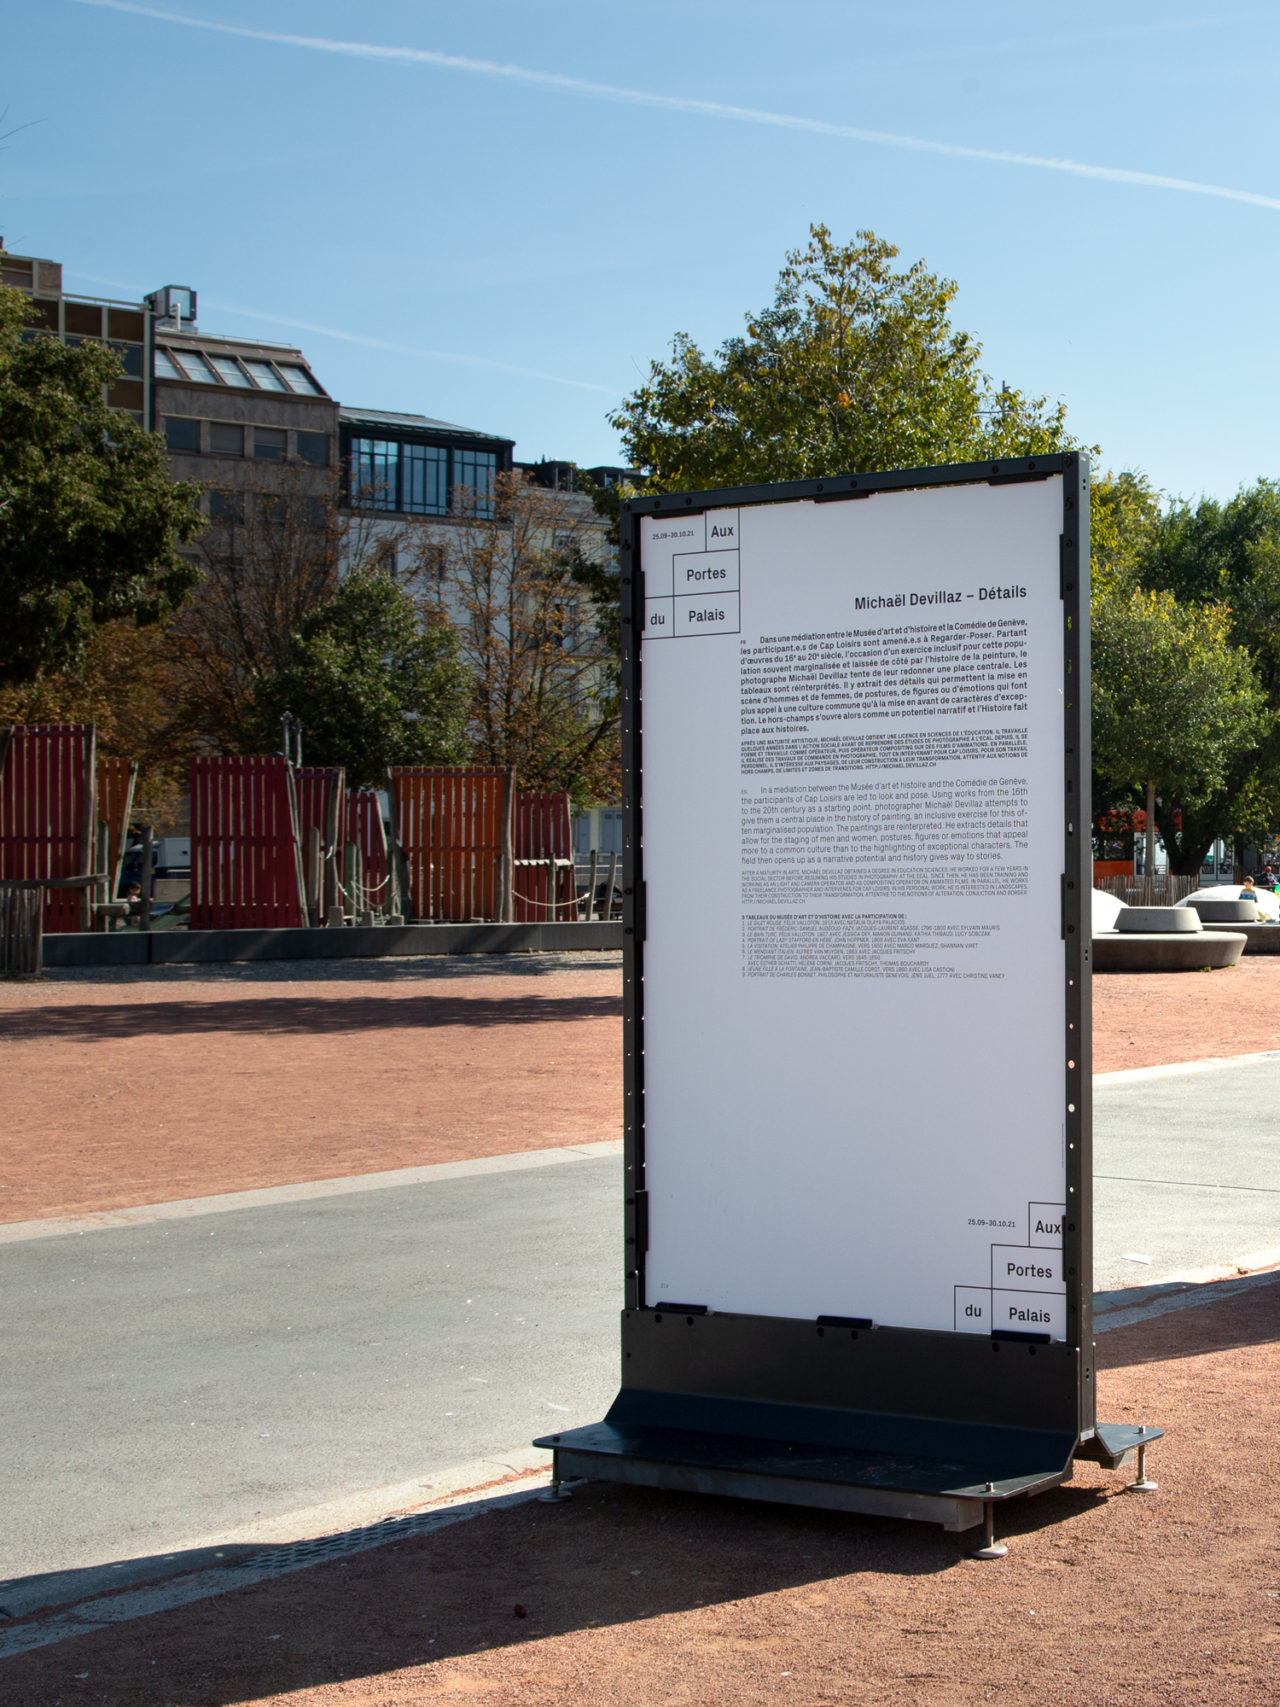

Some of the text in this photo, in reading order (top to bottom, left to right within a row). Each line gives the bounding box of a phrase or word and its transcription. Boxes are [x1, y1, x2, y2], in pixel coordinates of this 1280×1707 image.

[711, 526, 734, 537] Aux
[687, 568, 726, 581] Portes
[855, 594, 905, 609] Michaël
[910, 591, 962, 606] Devillaz
[979, 585, 1026, 600] Détails
[650, 609, 725, 625] du Palais
[792, 633, 825, 641] médiation
[853, 629, 876, 637] Musée
[955, 621, 986, 630] Comédie
[988, 620, 997, 628] de
[820, 642, 834, 651] Cap
[836, 640, 861, 648] Loisirs
[863, 639, 880, 647] sont
[997, 629, 1027, 637] Partant
[901, 646, 932, 654] exercice
[934, 643, 962, 652] inclusif
[963, 644, 980, 652] pour
[982, 641, 1003, 649] cette
[1004, 641, 1027, 649] popu-
[763, 665, 792, 673] souvent
[794, 662, 840, 672] marginalisée
[852, 660, 878, 668] laissée
[892, 657, 908, 665] côté
[910, 658, 923, 666] par
[741, 676, 787, 686] photographe
[789, 672, 817, 682] Michaël
[819, 672, 848, 680] Devillaz
[900, 667, 934, 675] redonner
[953, 664, 974, 674] place
[741, 685, 772, 694] tableaux
[774, 685, 789, 693] sont
[857, 680, 882, 688] extrait
[899, 677, 925, 686] détails
[927, 676, 939, 685] qui
[942, 674, 985, 685] permettent
[997, 672, 1015, 680] mise
[901, 688, 911, 696] de
[912, 688, 939, 696] figures
[997, 683, 1009, 692] qui
[741, 707, 756, 716] plus
[757, 706, 776, 715] appel
[917, 697, 939, 705] avant
[951, 695, 992, 703] caractères
[768, 715, 814, 723] hors-champs
[902, 708, 936, 718] potentiel
[937, 706, 966, 714] narratif
[741, 728, 760, 736] place
[1035, 1220, 1061, 1234] Aux
[1007, 1263, 1052, 1278] Portes
[965, 1304, 1051, 1322] du Palais
